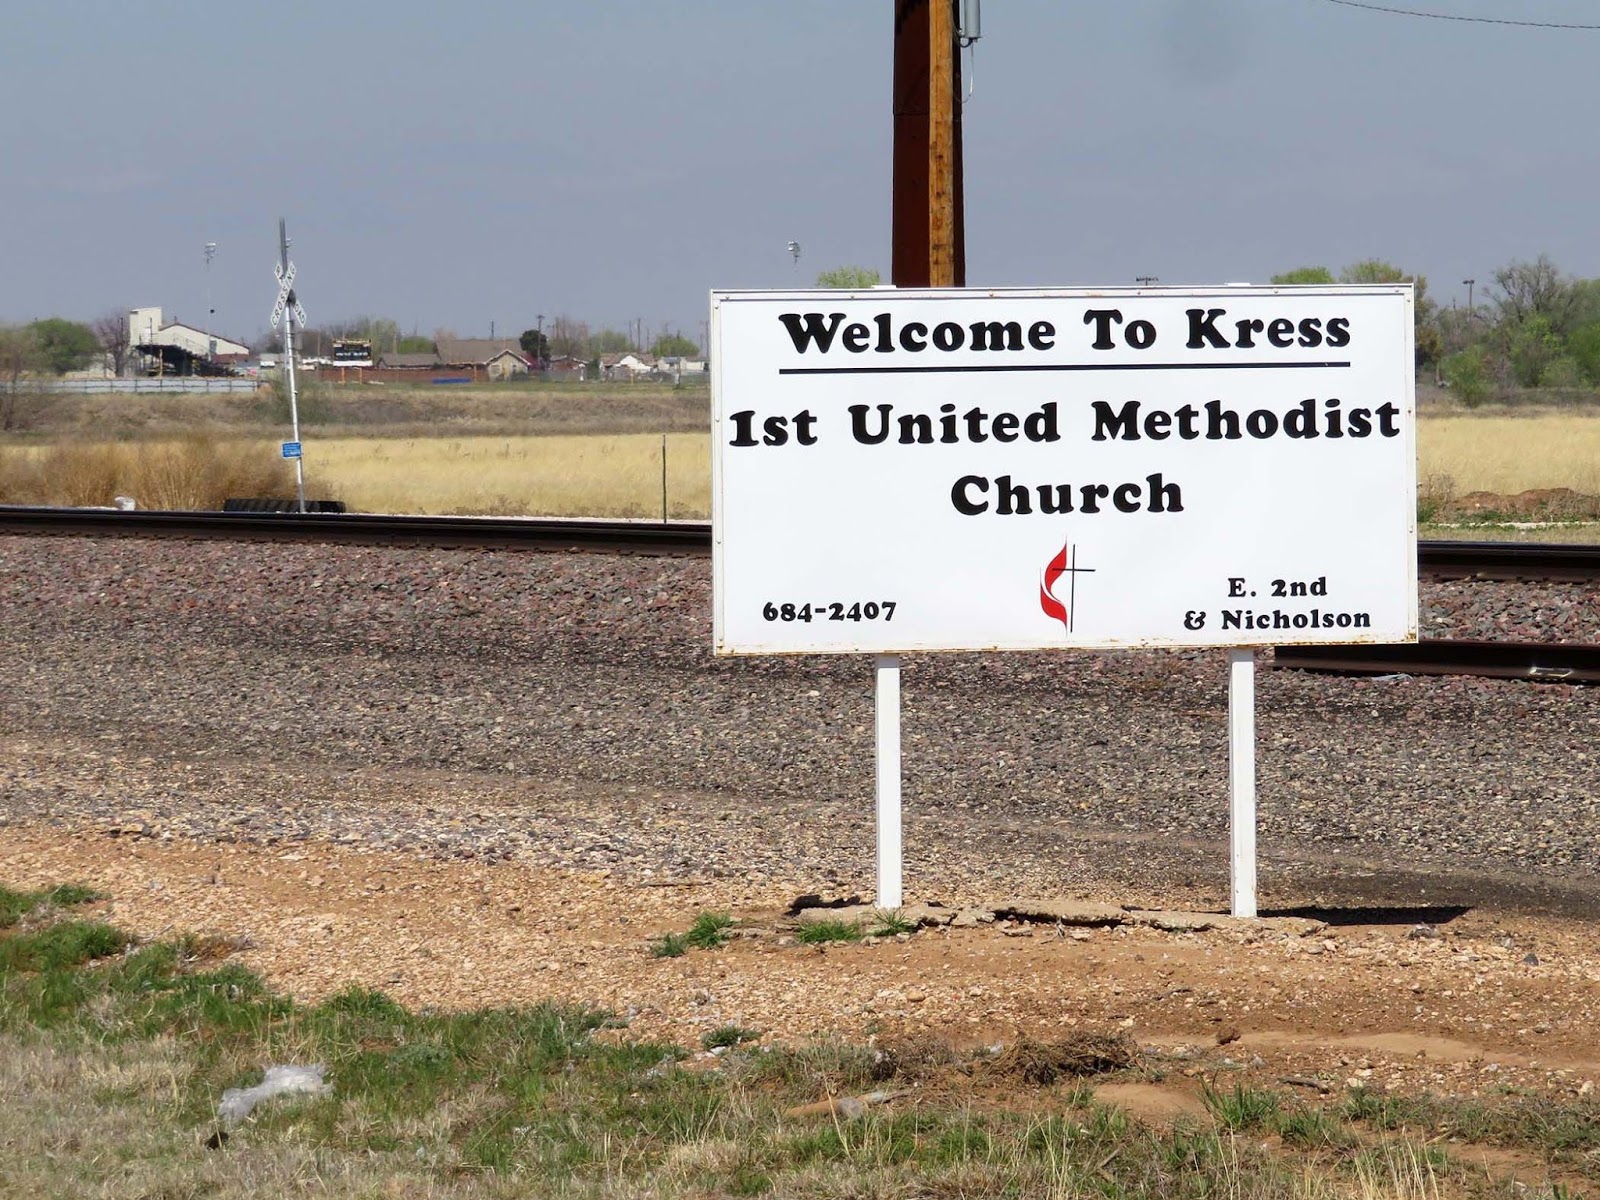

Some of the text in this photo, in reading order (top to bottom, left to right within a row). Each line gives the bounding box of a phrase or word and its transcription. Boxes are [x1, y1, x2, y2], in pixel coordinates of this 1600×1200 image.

[272, 265, 295, 325] CROSSING
[779, 308, 1351, 356] Welcome To Kress
[729, 399, 1400, 447] 1st United Methodist
[951, 473, 1185, 516] Church
[1228, 577, 1328, 598] E. 2nd
[763, 601, 897, 622] 684-2407
[1184, 608, 1371, 631] & Nicholson
